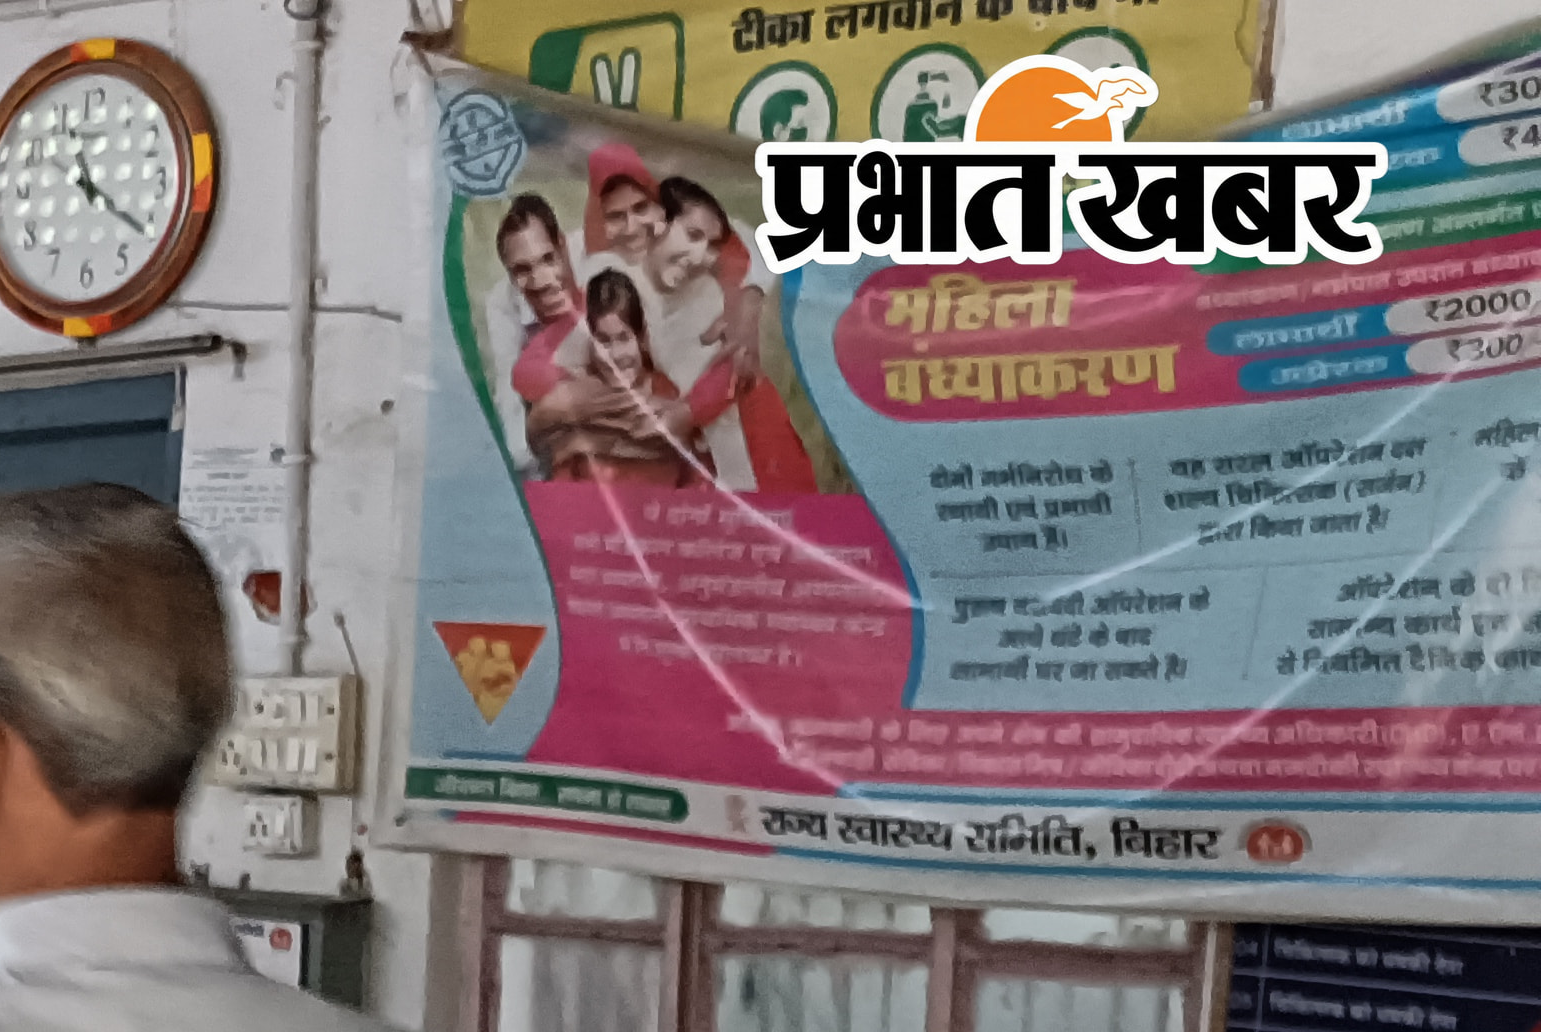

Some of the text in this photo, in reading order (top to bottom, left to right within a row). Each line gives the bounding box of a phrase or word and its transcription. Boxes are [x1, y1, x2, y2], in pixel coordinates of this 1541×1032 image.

[732, 6, 815, 54] टीका
[1480, 75, 1541, 107] ₹30
[1503, 123, 1541, 150] ₹4
[46, 248, 61, 277] 7
[79, 258, 94, 289] 6
[115, 243, 129, 276] 5
[884, 272, 1078, 333] महिला
[1424, 287, 1532, 323] ₹2000
[1445, 333, 1524, 363] ₹300
[760, 804, 1224, 862] राज्य स्वास्थ्य समिति, बिहार
